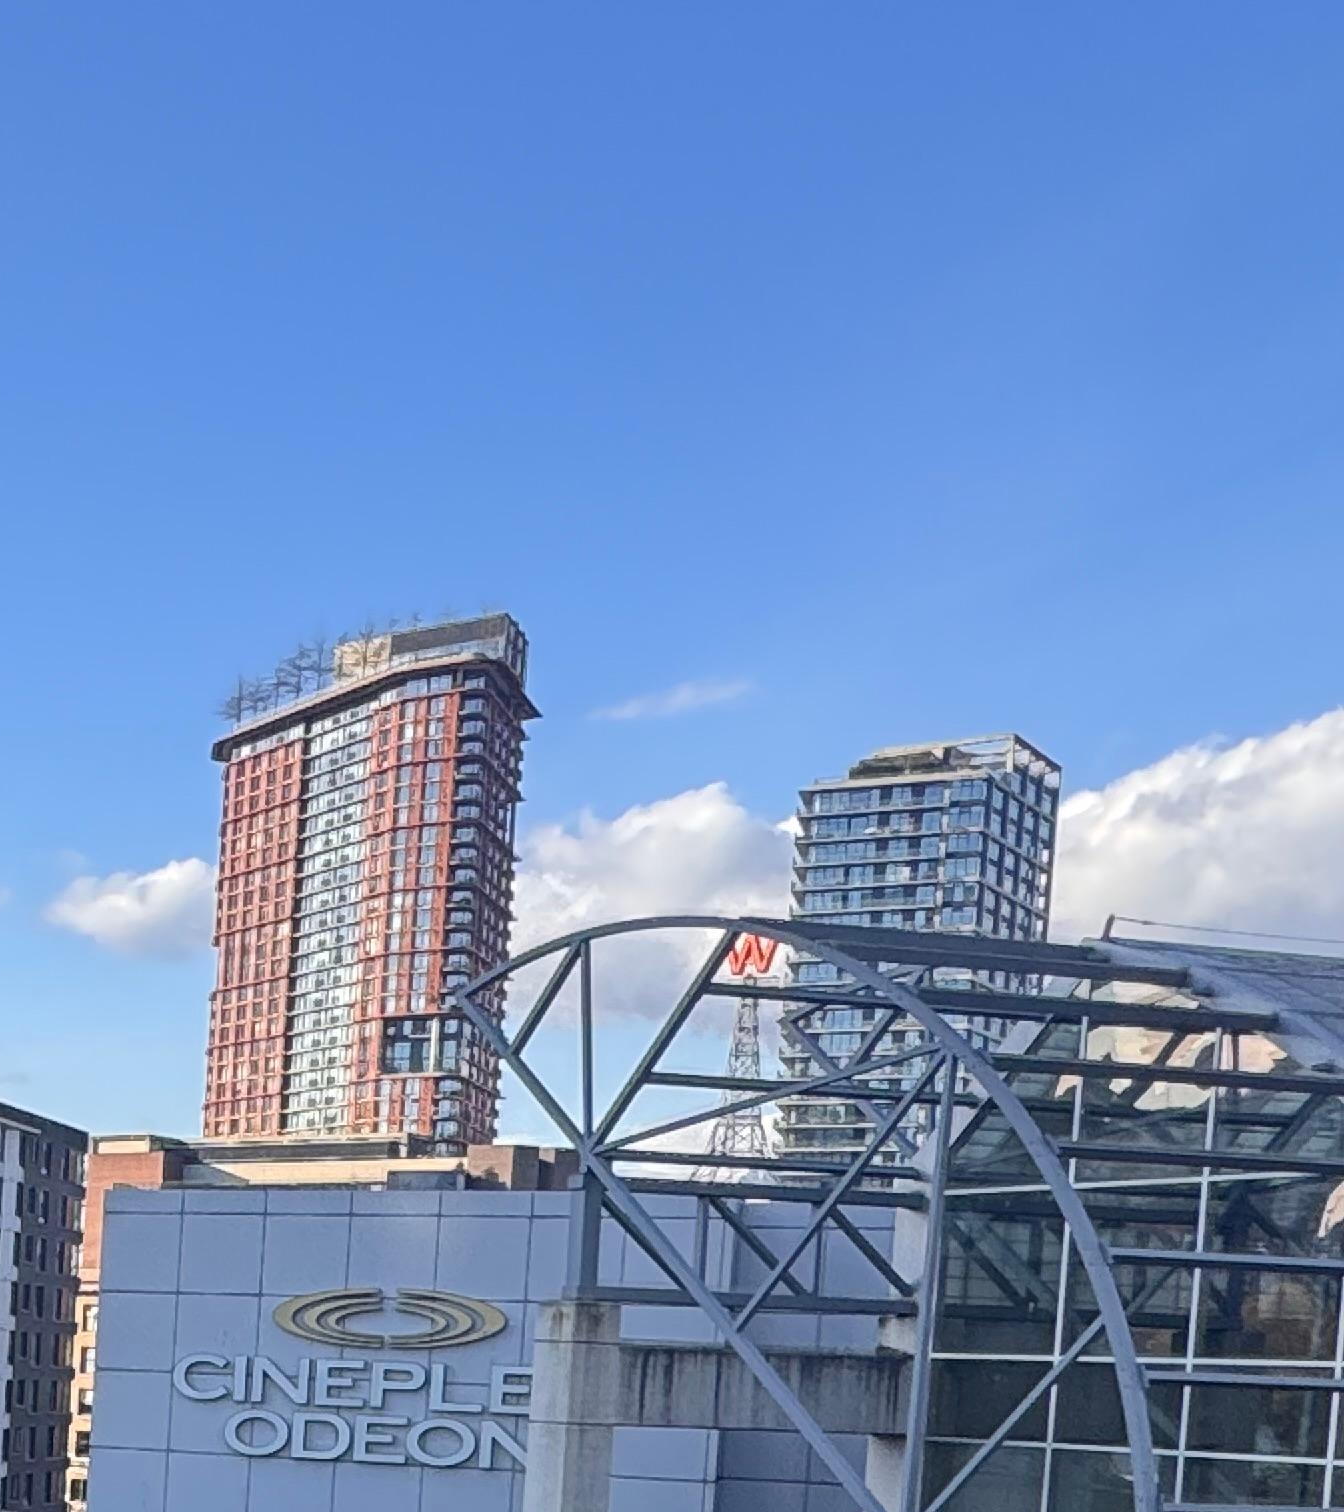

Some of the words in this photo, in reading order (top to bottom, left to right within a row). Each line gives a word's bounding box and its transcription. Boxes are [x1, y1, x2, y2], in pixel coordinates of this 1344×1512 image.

[729, 934, 776, 975] W
[172, 1353, 533, 1416] CINEPLE
[224, 1408, 526, 1468] ODEON
